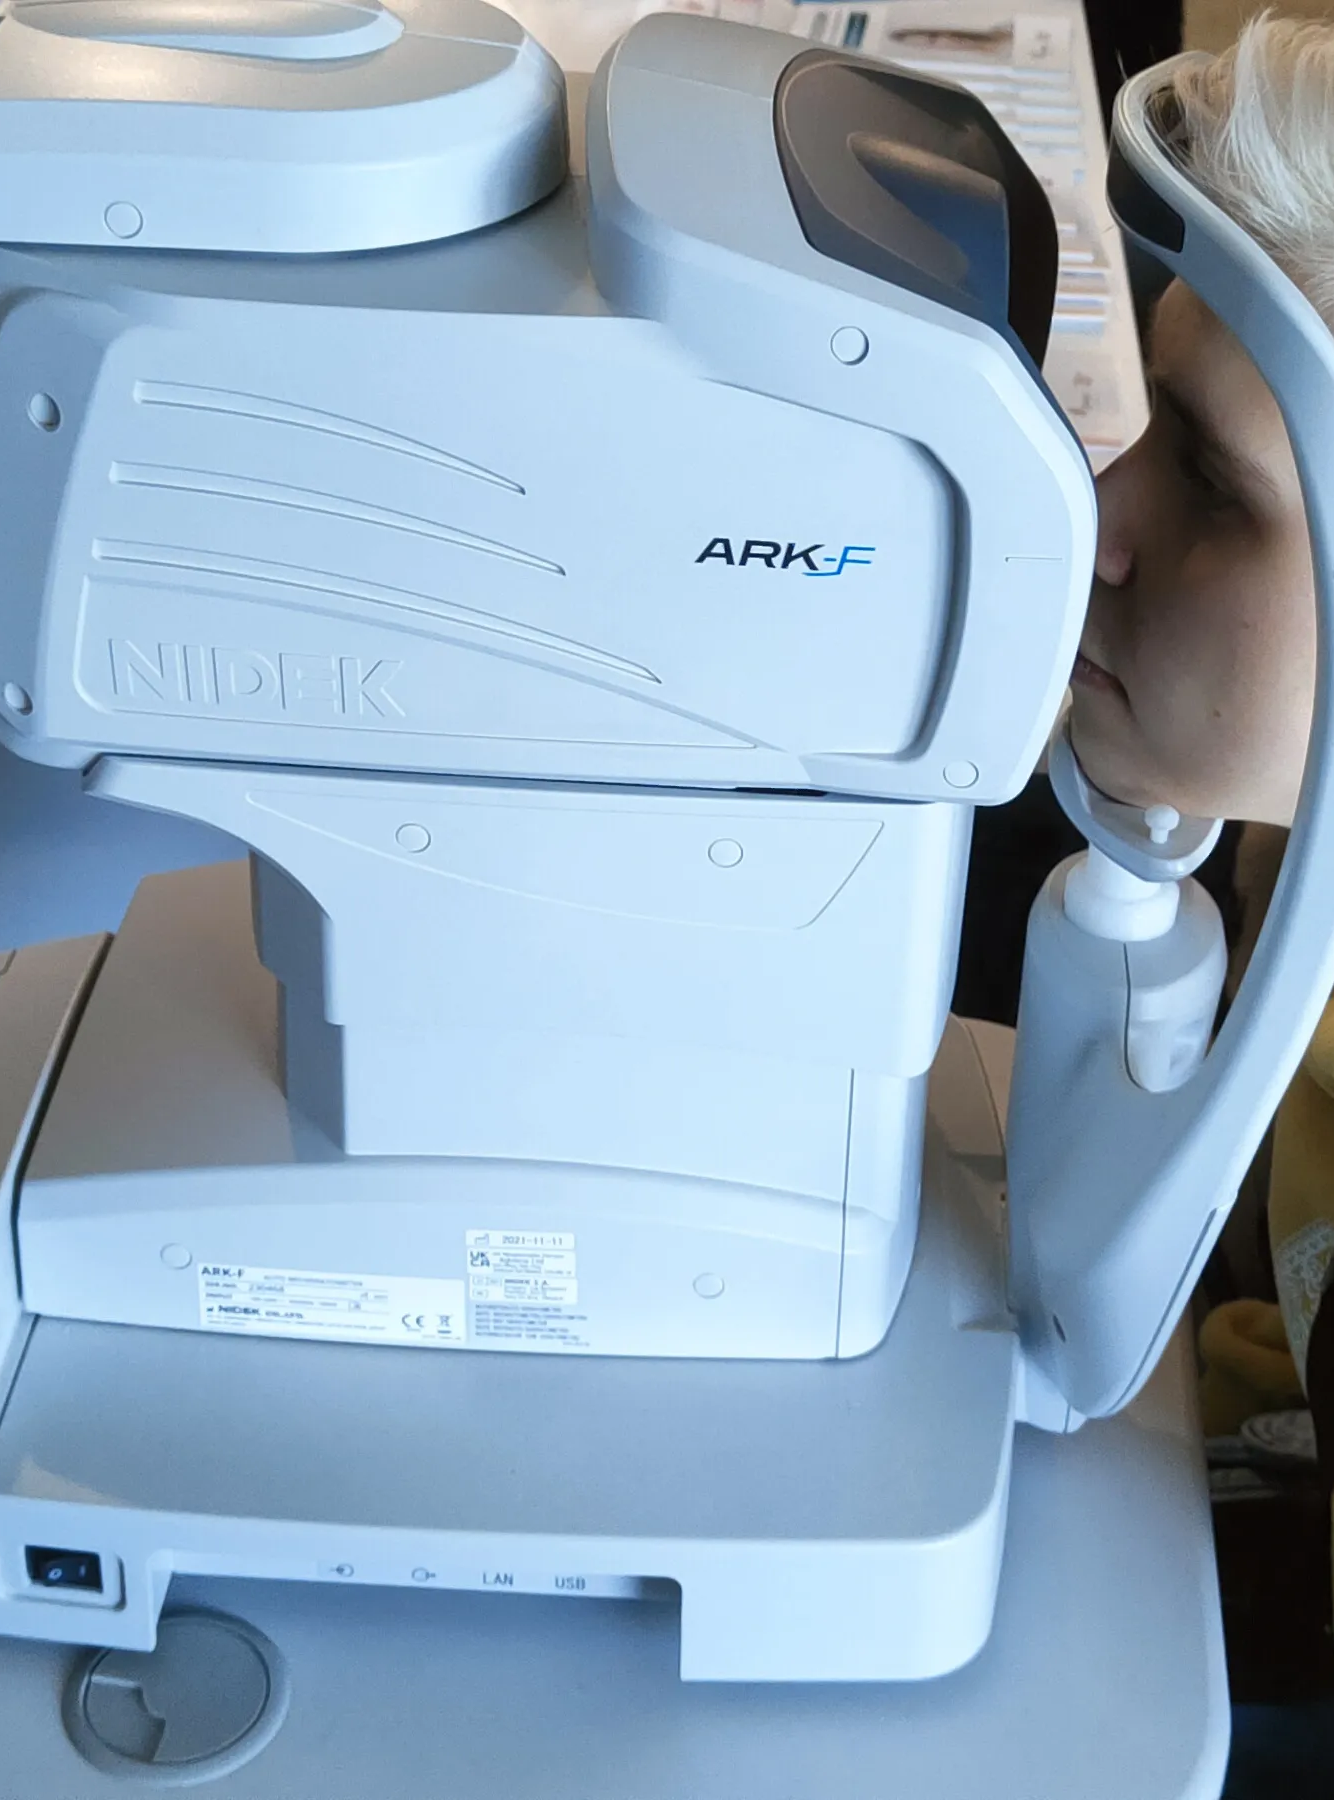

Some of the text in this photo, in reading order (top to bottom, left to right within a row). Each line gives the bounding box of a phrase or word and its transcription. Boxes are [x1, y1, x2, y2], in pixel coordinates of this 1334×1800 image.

[693, 537, 876, 577] ARK-F
[108, 638, 406, 718] NIDEK
[483, 1572, 586, 1590] LAN USB
